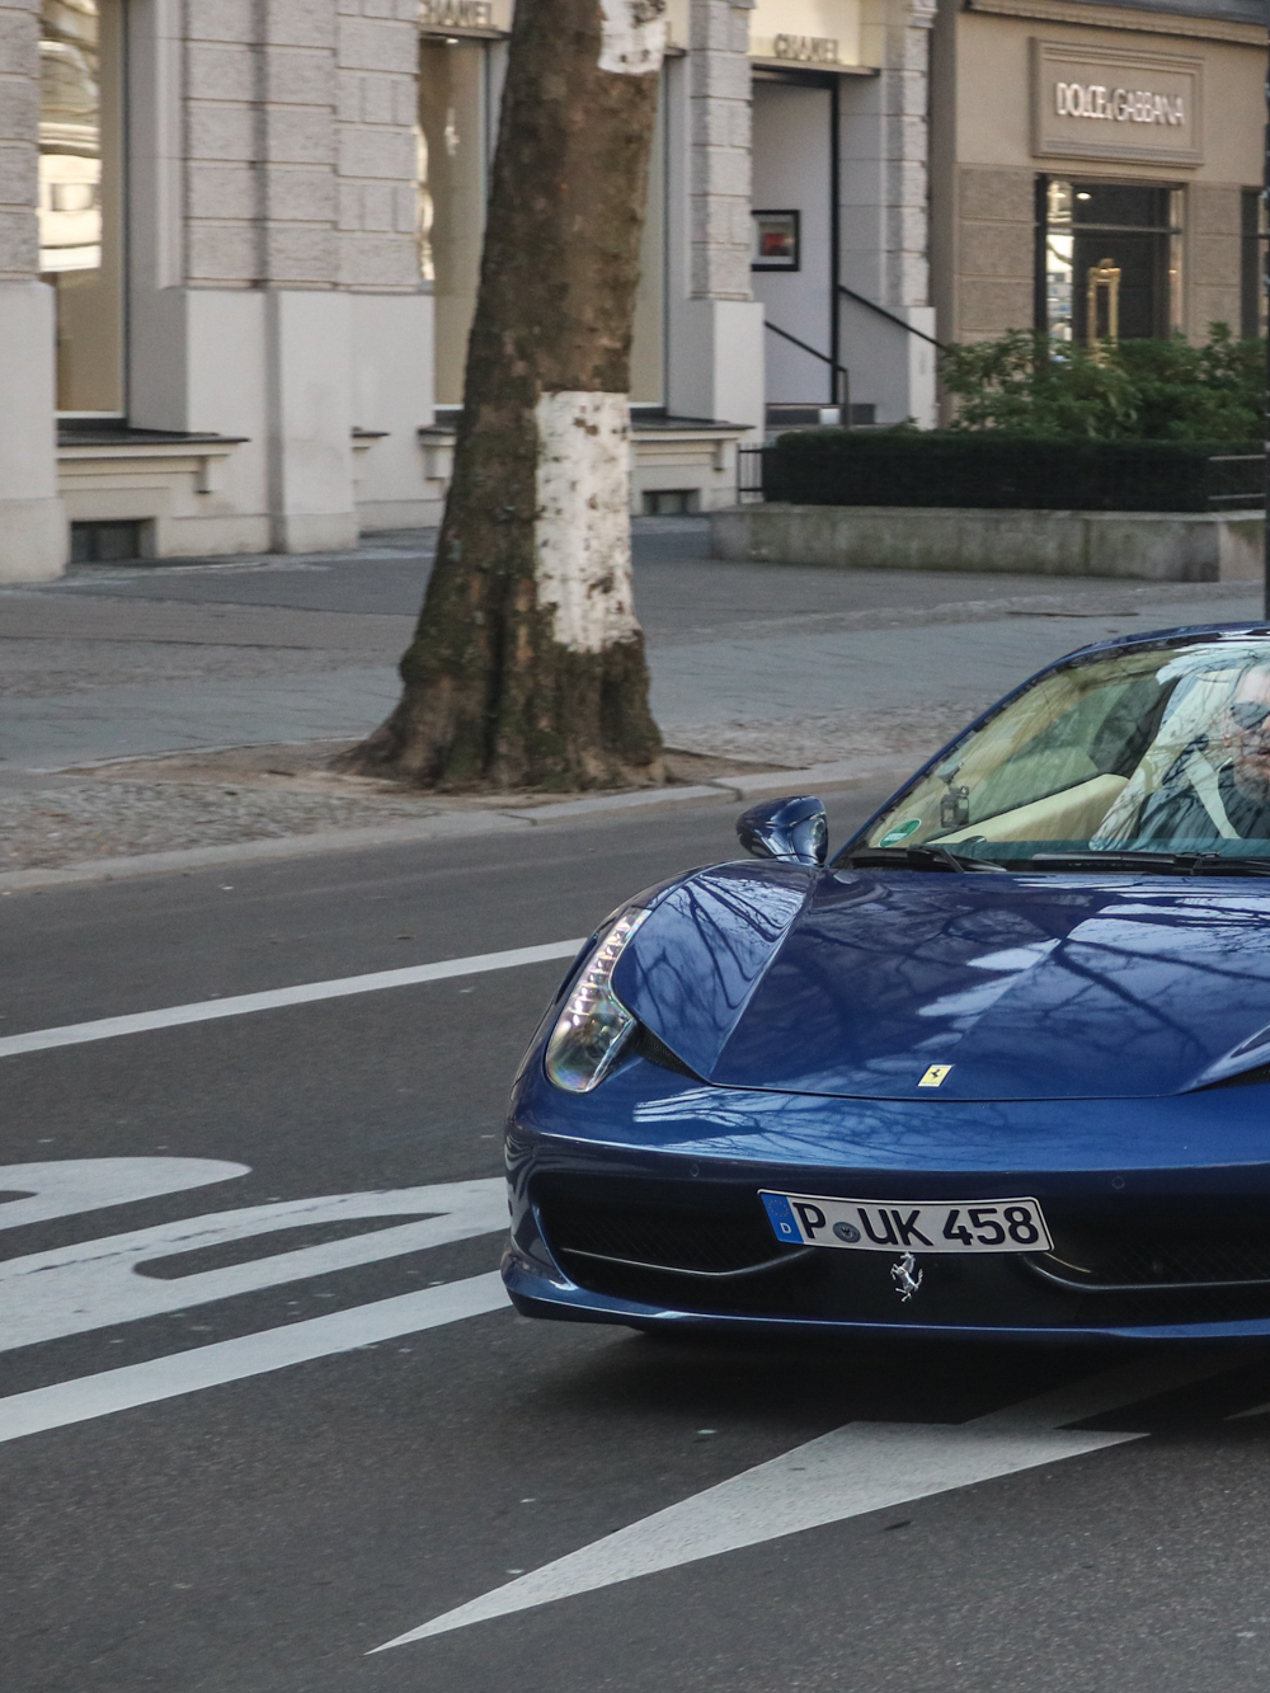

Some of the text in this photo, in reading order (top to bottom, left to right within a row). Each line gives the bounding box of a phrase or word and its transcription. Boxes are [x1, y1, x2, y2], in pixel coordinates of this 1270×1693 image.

[773, 33, 839, 64] CHANEL
[780, 1222, 792, 1234] D
[792, 1202, 1040, 1246] P UK 458
